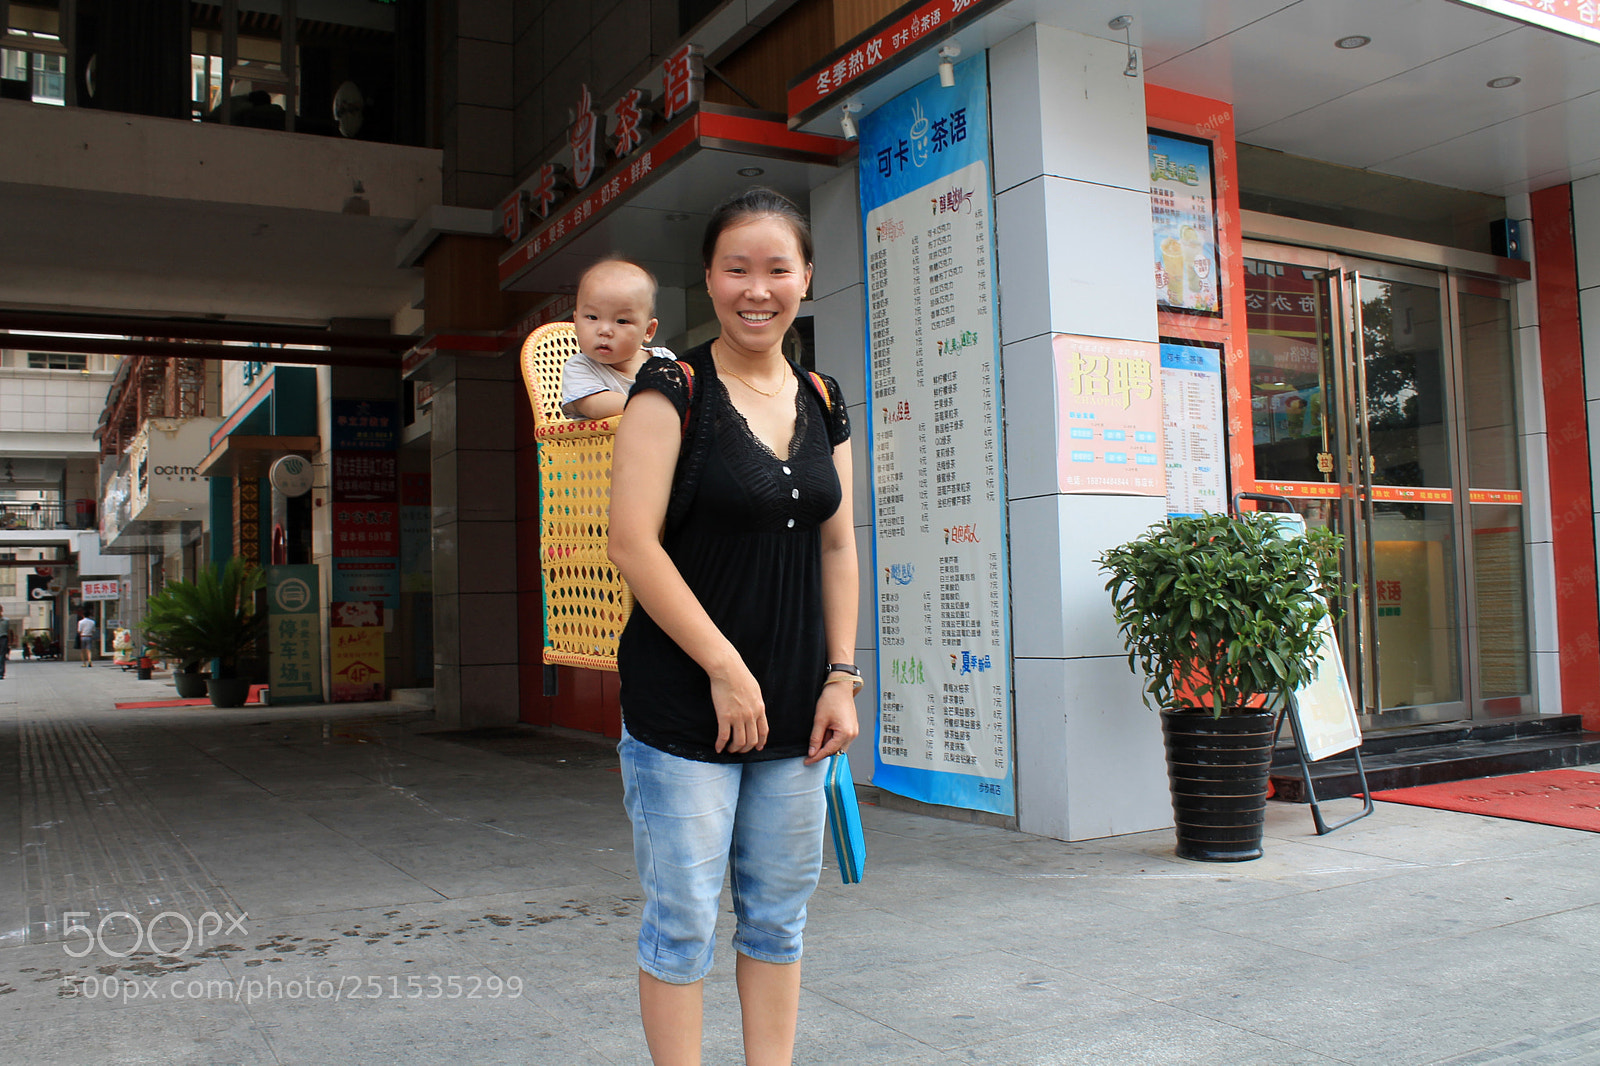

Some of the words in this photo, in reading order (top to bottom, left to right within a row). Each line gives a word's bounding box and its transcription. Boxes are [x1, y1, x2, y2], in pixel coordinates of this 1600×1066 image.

[891, 29, 909, 49] 可卡
[921, 8, 941, 33] 茶语
[816, 38, 883, 95] 冬季热饮
[1196, 112, 1231, 135] Coffee
[502, 163, 556, 242] 可卡
[614, 44, 692, 158] 茶语
[877, 139, 909, 178] 可卡
[931, 108, 967, 153] 茶语
[1151, 153, 1199, 186] 夏季新品
[1067, 351, 1153, 411] 招聘
[1300, 486, 1335, 495] 现磨咖啡
[338, 511, 392, 525] 中公教育
[1376, 580, 1402, 601] 茶语
[279, 619, 299, 681] 停车场
[351, 667, 367, 682] 4F
[960, 651, 992, 676] 夏季新品
[993, 685, 1000, 694] 7元
[993, 697, 1001, 707] 7元
[994, 734, 1002, 743] 7元
